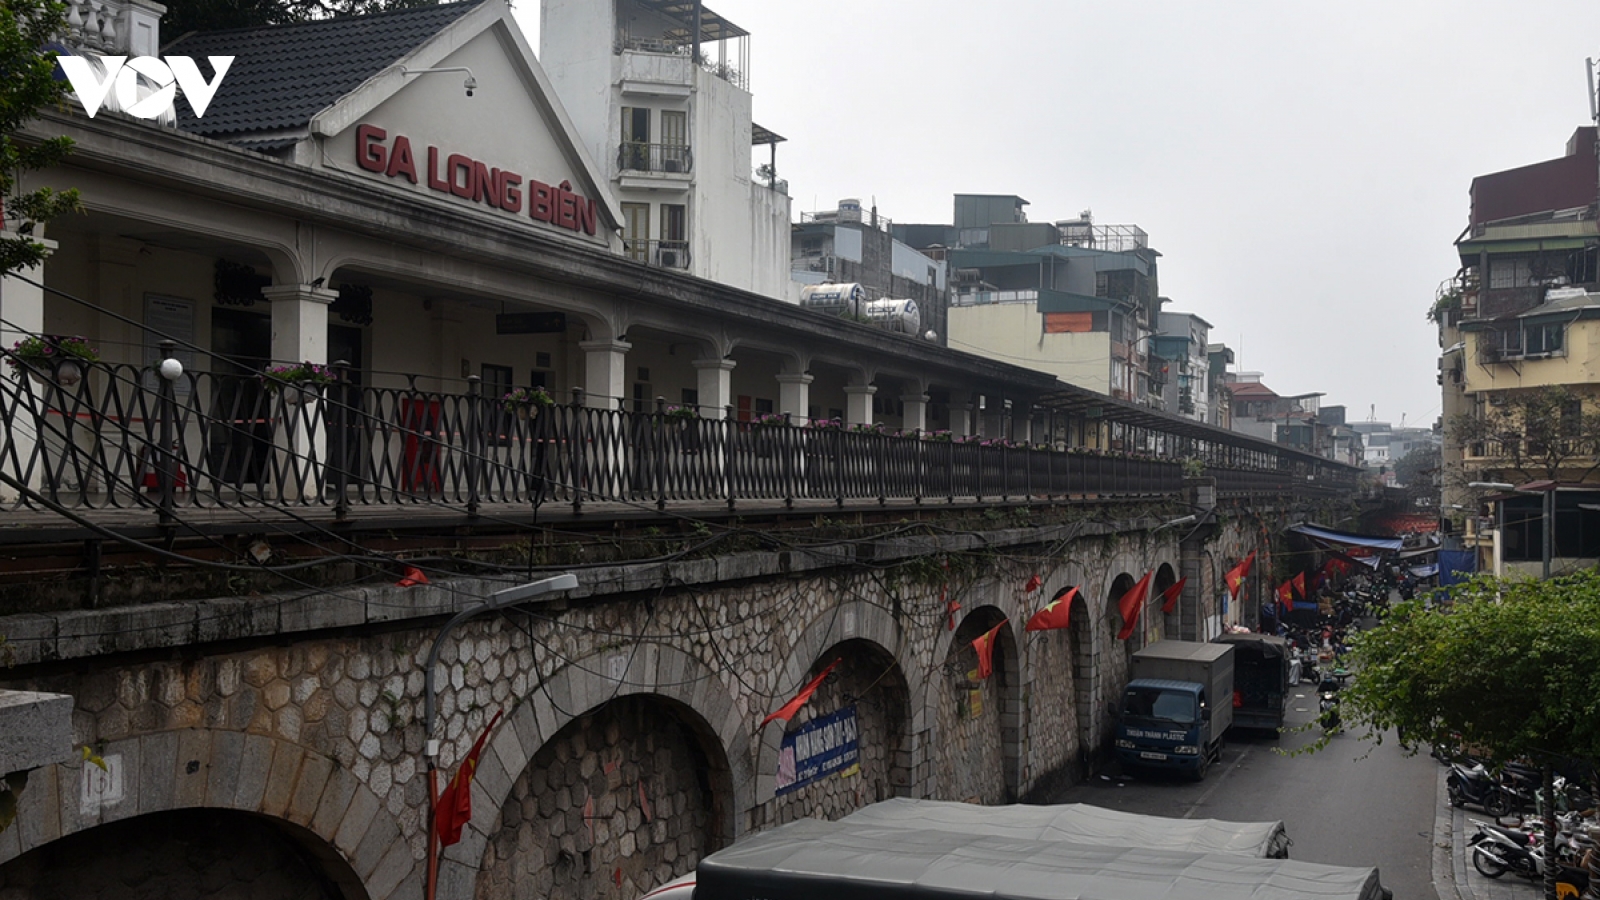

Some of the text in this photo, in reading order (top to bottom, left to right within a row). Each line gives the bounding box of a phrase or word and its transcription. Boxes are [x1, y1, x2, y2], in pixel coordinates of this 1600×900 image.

[356, 124, 597, 237] GA LONG BIÊN
[1162, 732, 1184, 741] PLASTIC
